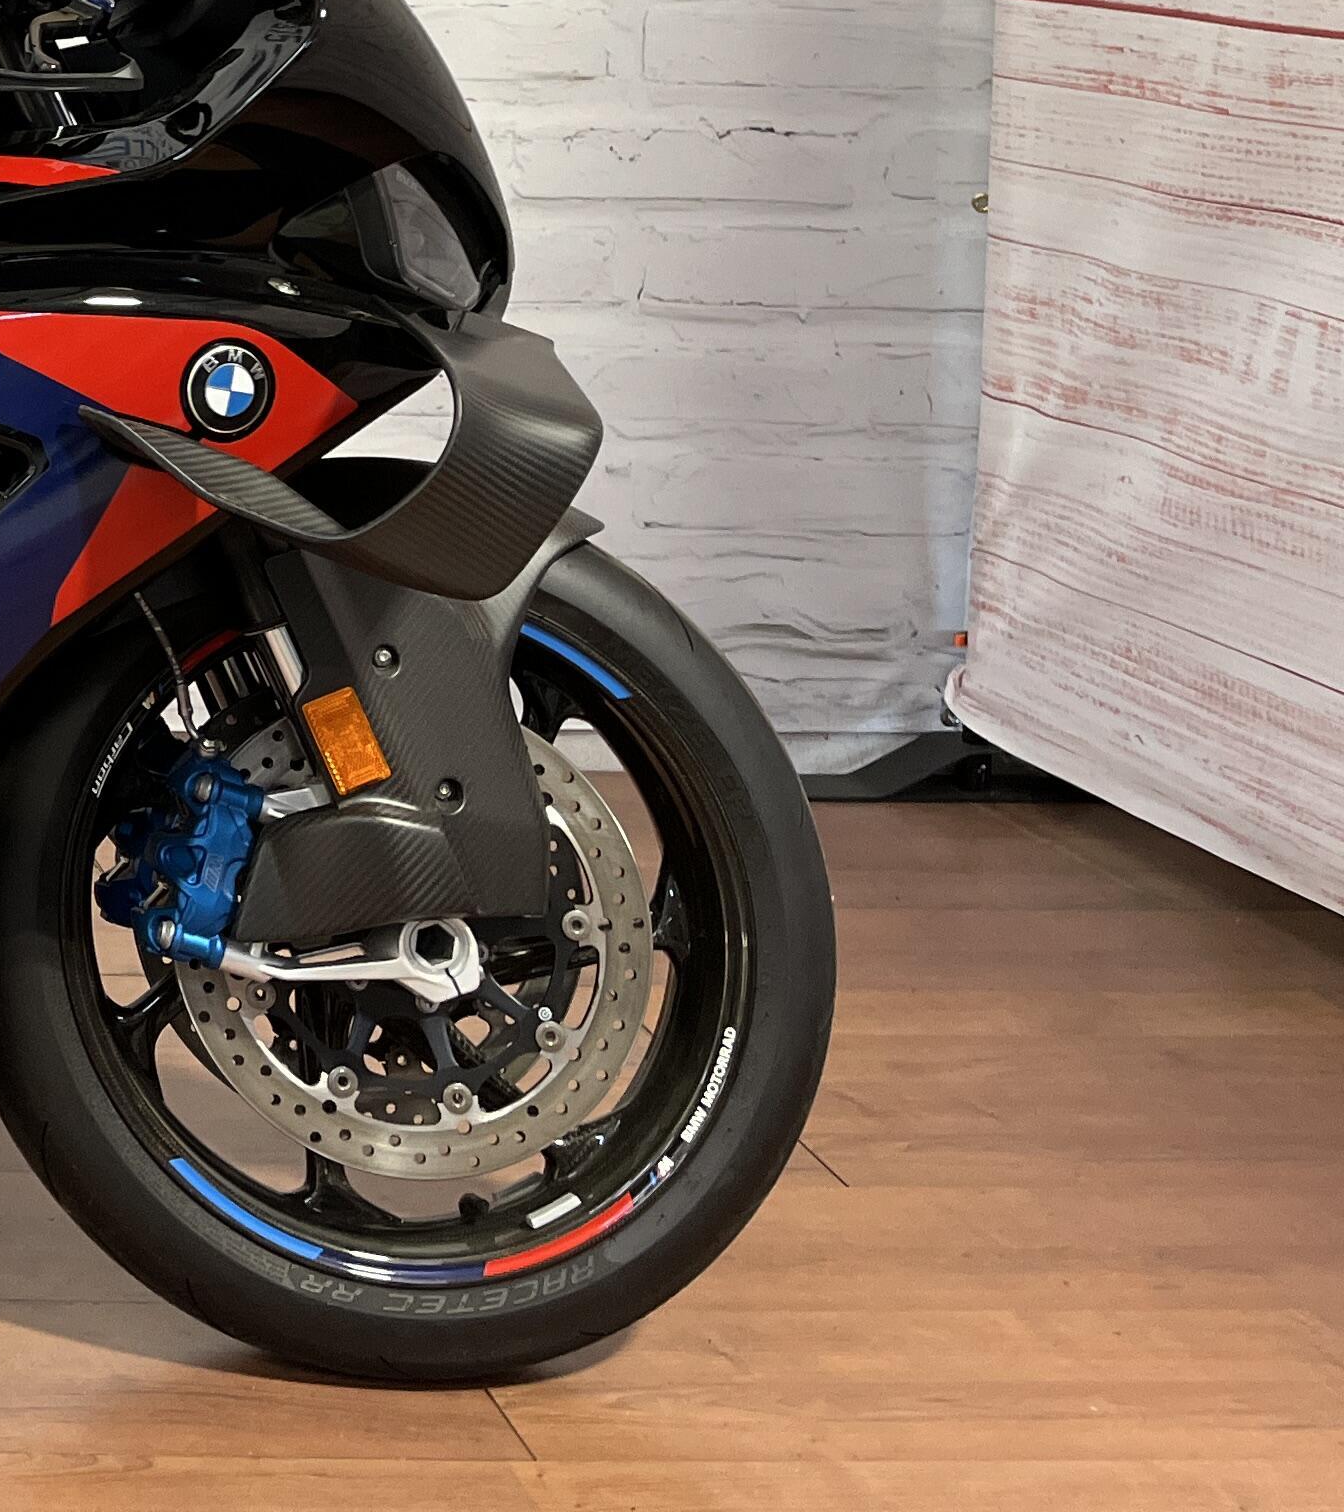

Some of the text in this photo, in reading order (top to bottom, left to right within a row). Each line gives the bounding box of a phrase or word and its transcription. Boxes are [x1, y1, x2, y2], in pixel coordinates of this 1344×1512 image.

[202, 348, 265, 381] BMW
[680, 1026, 737, 1144] BMW MOTORRAD
[382, 1255, 596, 1314] RACETEC
